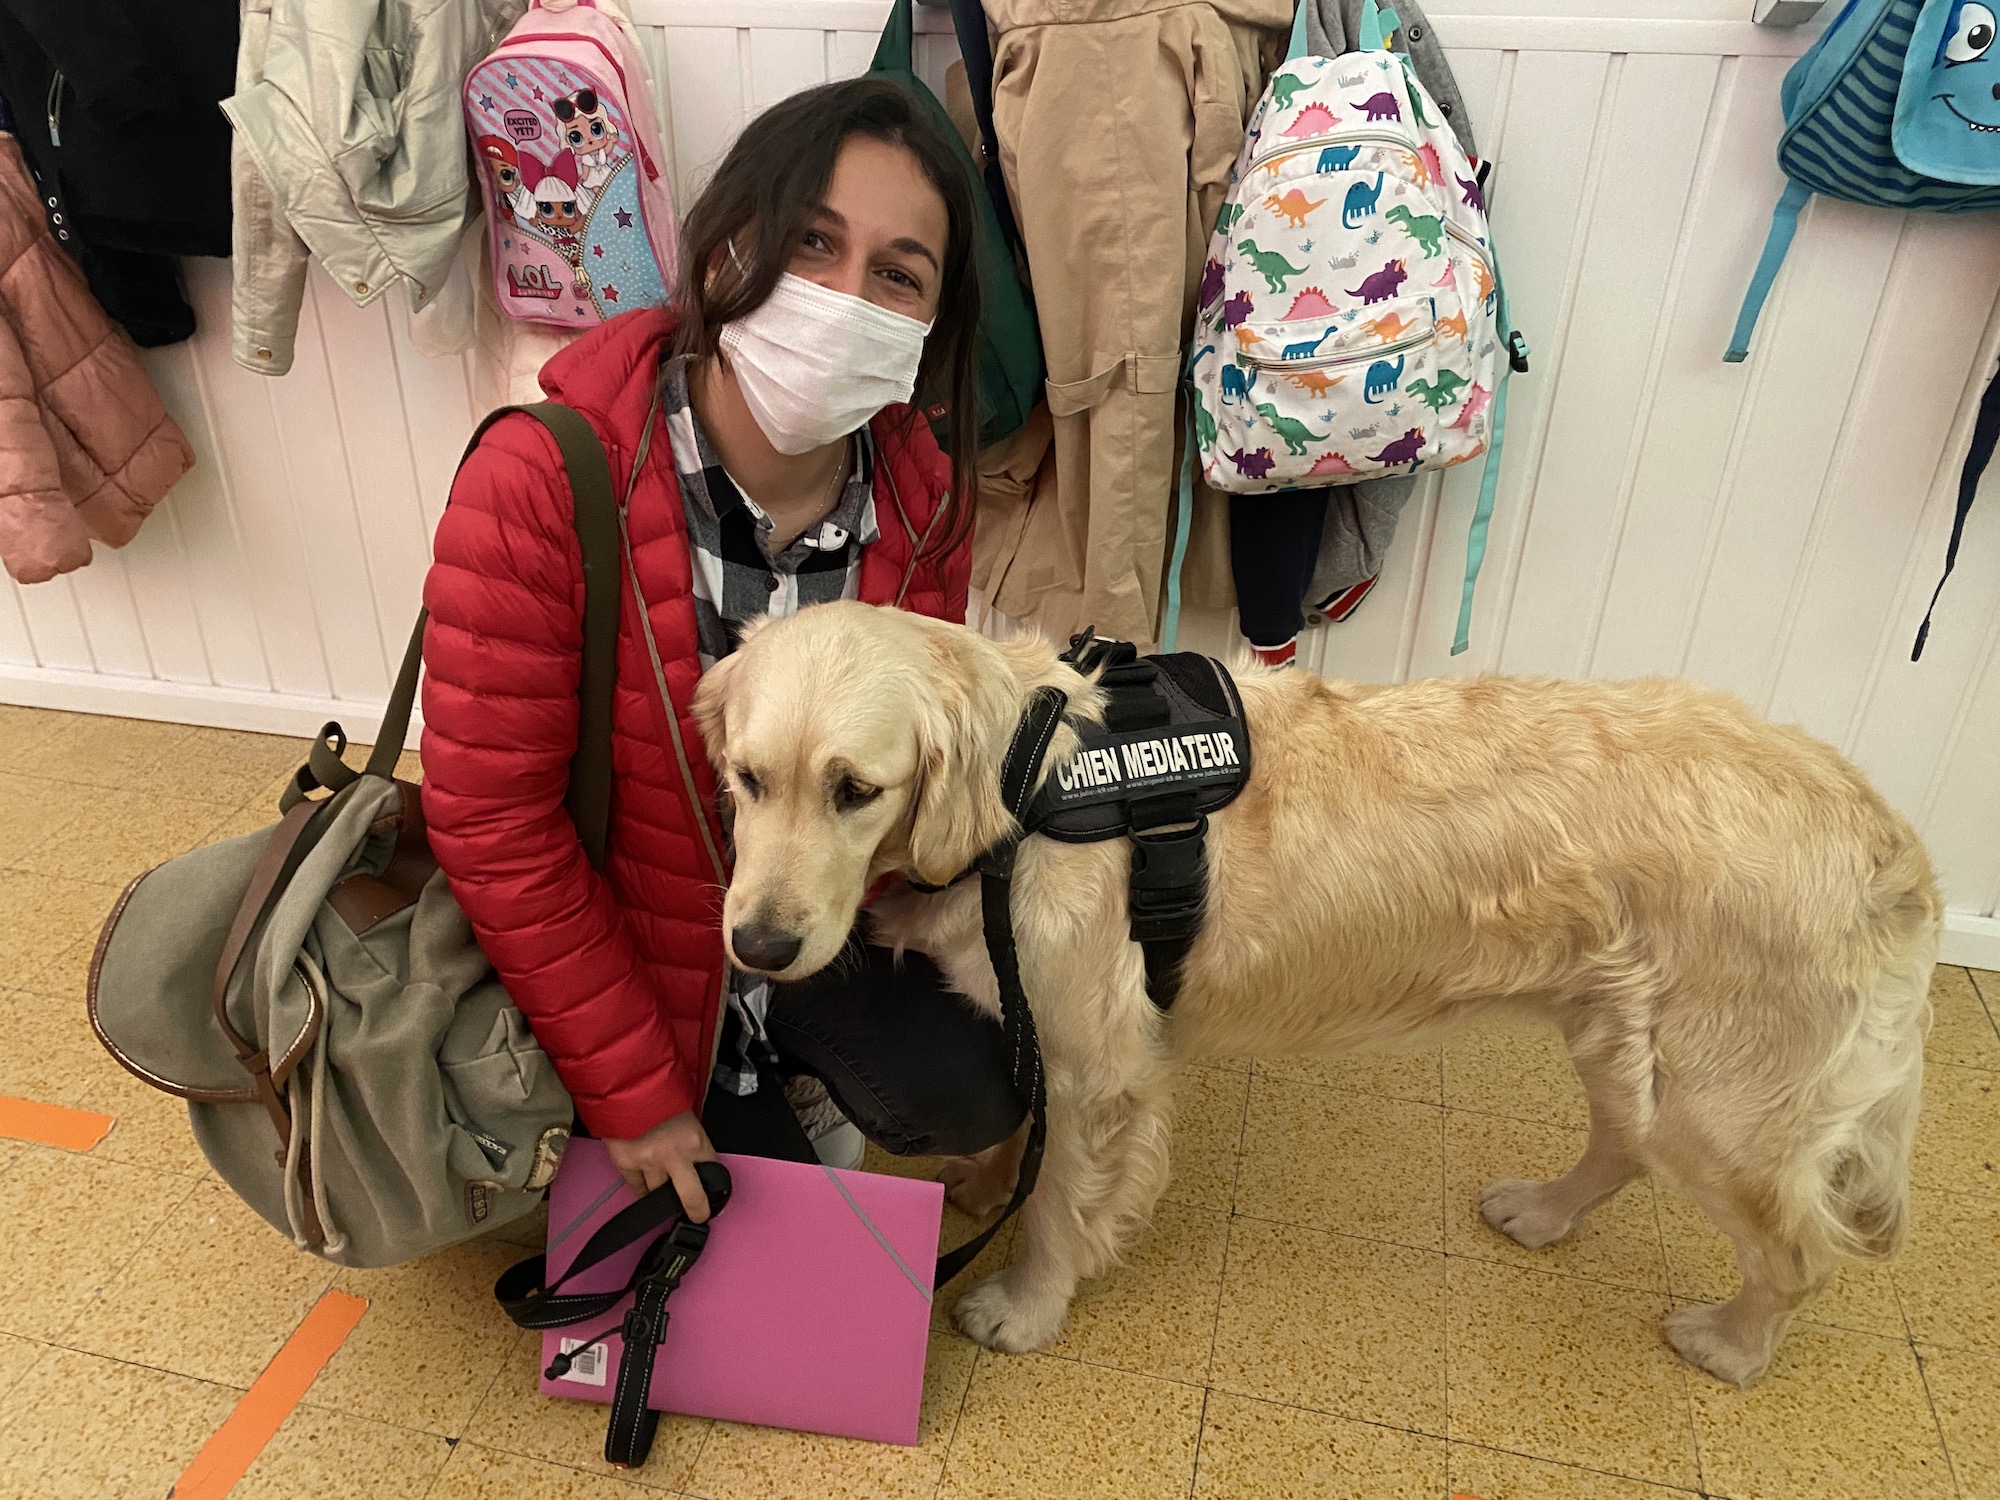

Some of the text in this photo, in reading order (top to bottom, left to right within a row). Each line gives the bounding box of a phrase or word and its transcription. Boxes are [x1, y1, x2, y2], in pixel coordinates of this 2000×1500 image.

[507, 118, 538, 126] EXCITED
[507, 264, 564, 291] LOL
[1056, 732, 1240, 791] CHIEN MEDIATEUR
